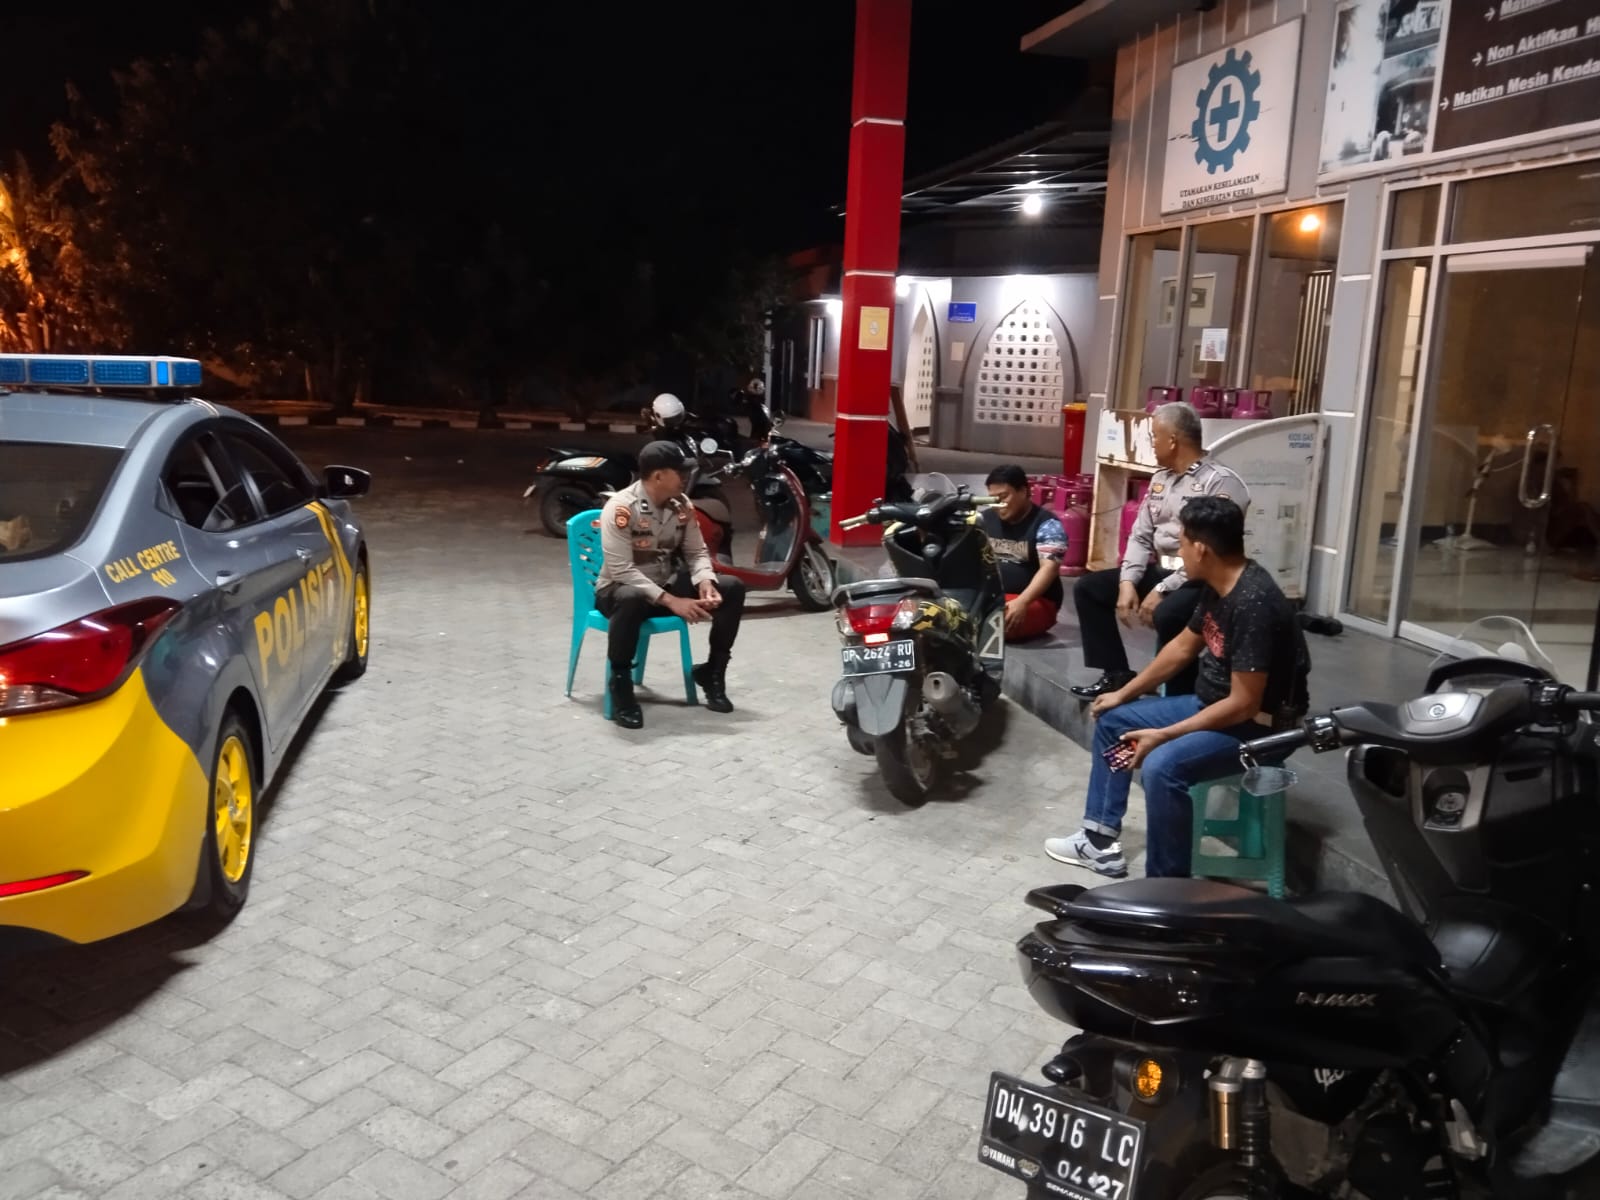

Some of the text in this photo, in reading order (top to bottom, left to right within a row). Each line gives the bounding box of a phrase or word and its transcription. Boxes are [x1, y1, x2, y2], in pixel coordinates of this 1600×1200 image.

[1487, 44, 1514, 62] Non
[1517, 26, 1578, 54] Aktifkan
[1453, 84, 1504, 107] Matikan
[1507, 71, 1549, 94] Mesin
[1180, 174, 1259, 197] UTAMAKAN KESELAMATAN
[1196, 192, 1231, 205] KESEHATAN
[1232, 187, 1253, 198] KERJA
[105, 540, 181, 584] CALL CENTRE
[151, 568, 177, 588] 110
[254, 563, 326, 689] POLISI
[897, 643, 912, 656] RU
[995, 1089, 1134, 1167] DW 3916 LC
[989, 1148, 1016, 1169] YAMAHA
[1057, 1160, 1082, 1185] 04
[1095, 1174, 1125, 1200] 27
